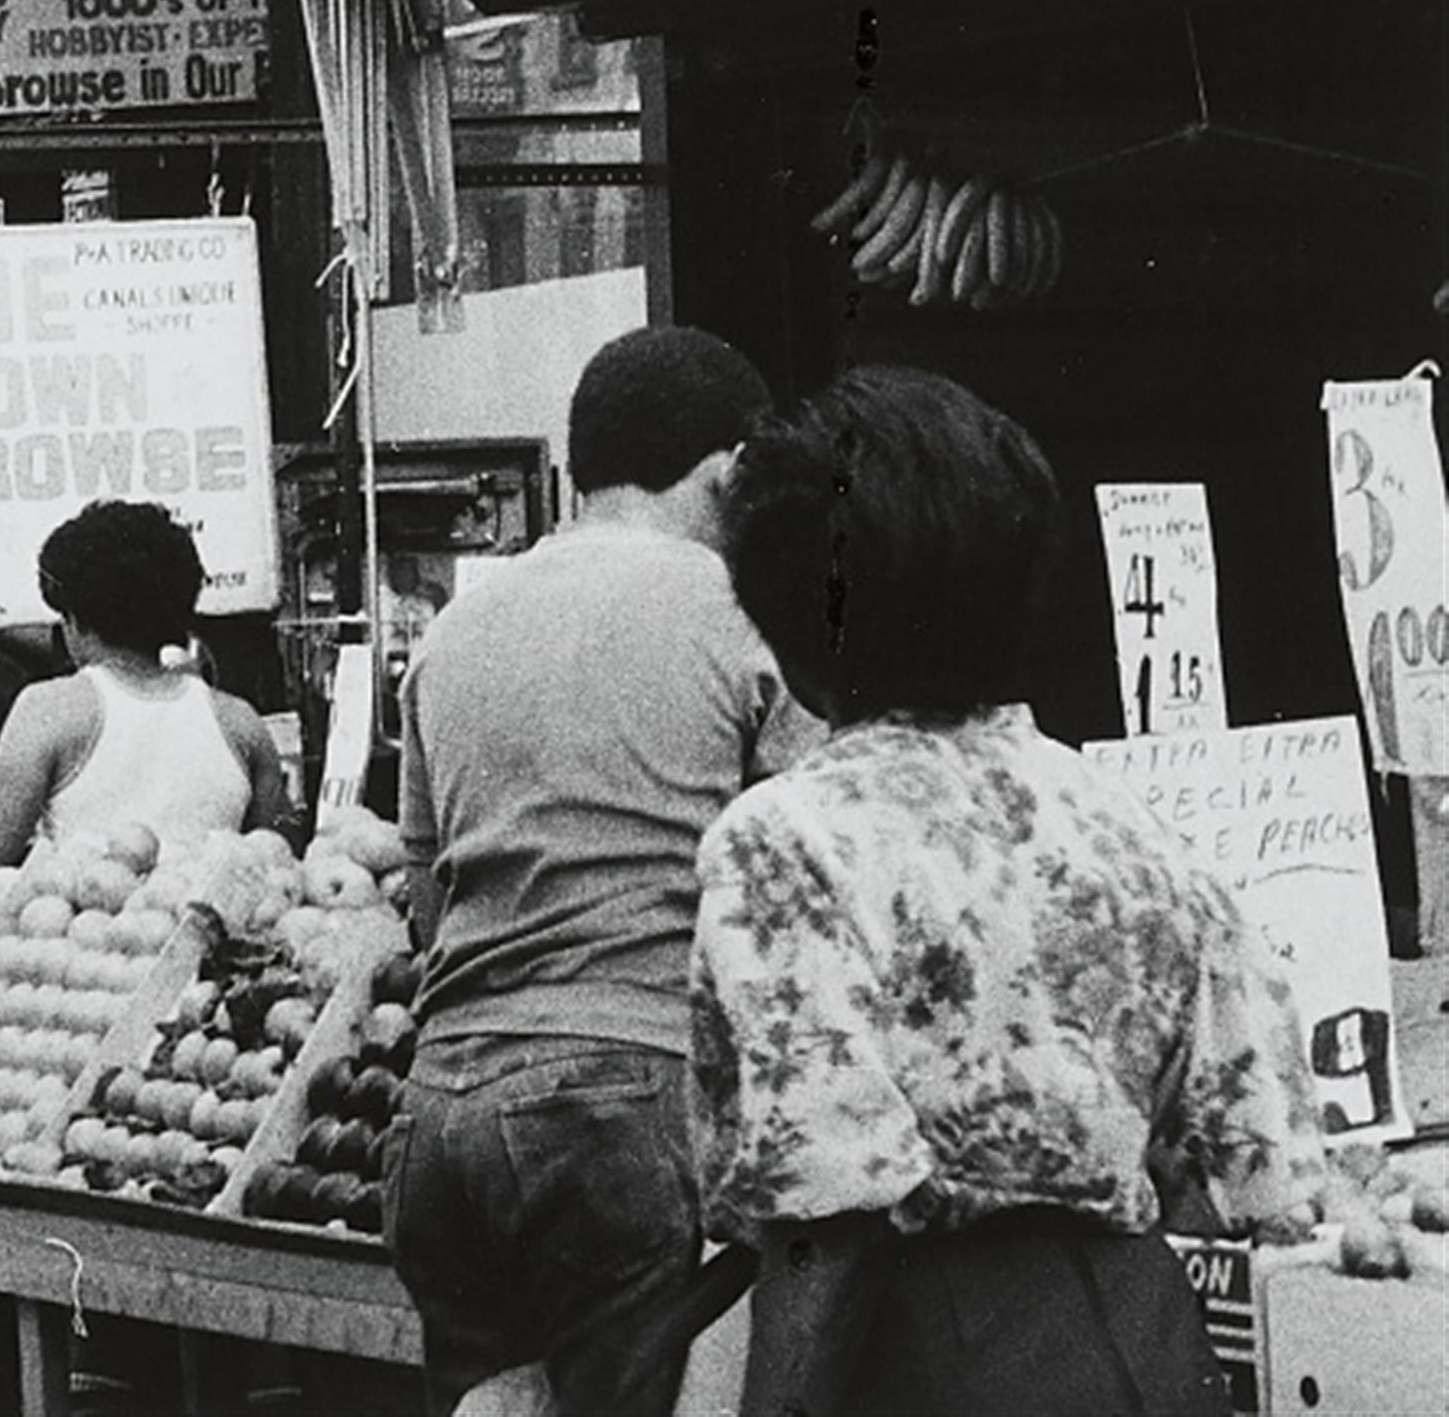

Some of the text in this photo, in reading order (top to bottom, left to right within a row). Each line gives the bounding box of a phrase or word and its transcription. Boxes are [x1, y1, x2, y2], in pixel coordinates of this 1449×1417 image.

[28, 23, 170, 59] HOBBYIST
[139, 57, 170, 102] in
[185, 52, 243, 99] Our
[1335, 429, 1394, 592] 3
[1123, 553, 1165, 639] 4
